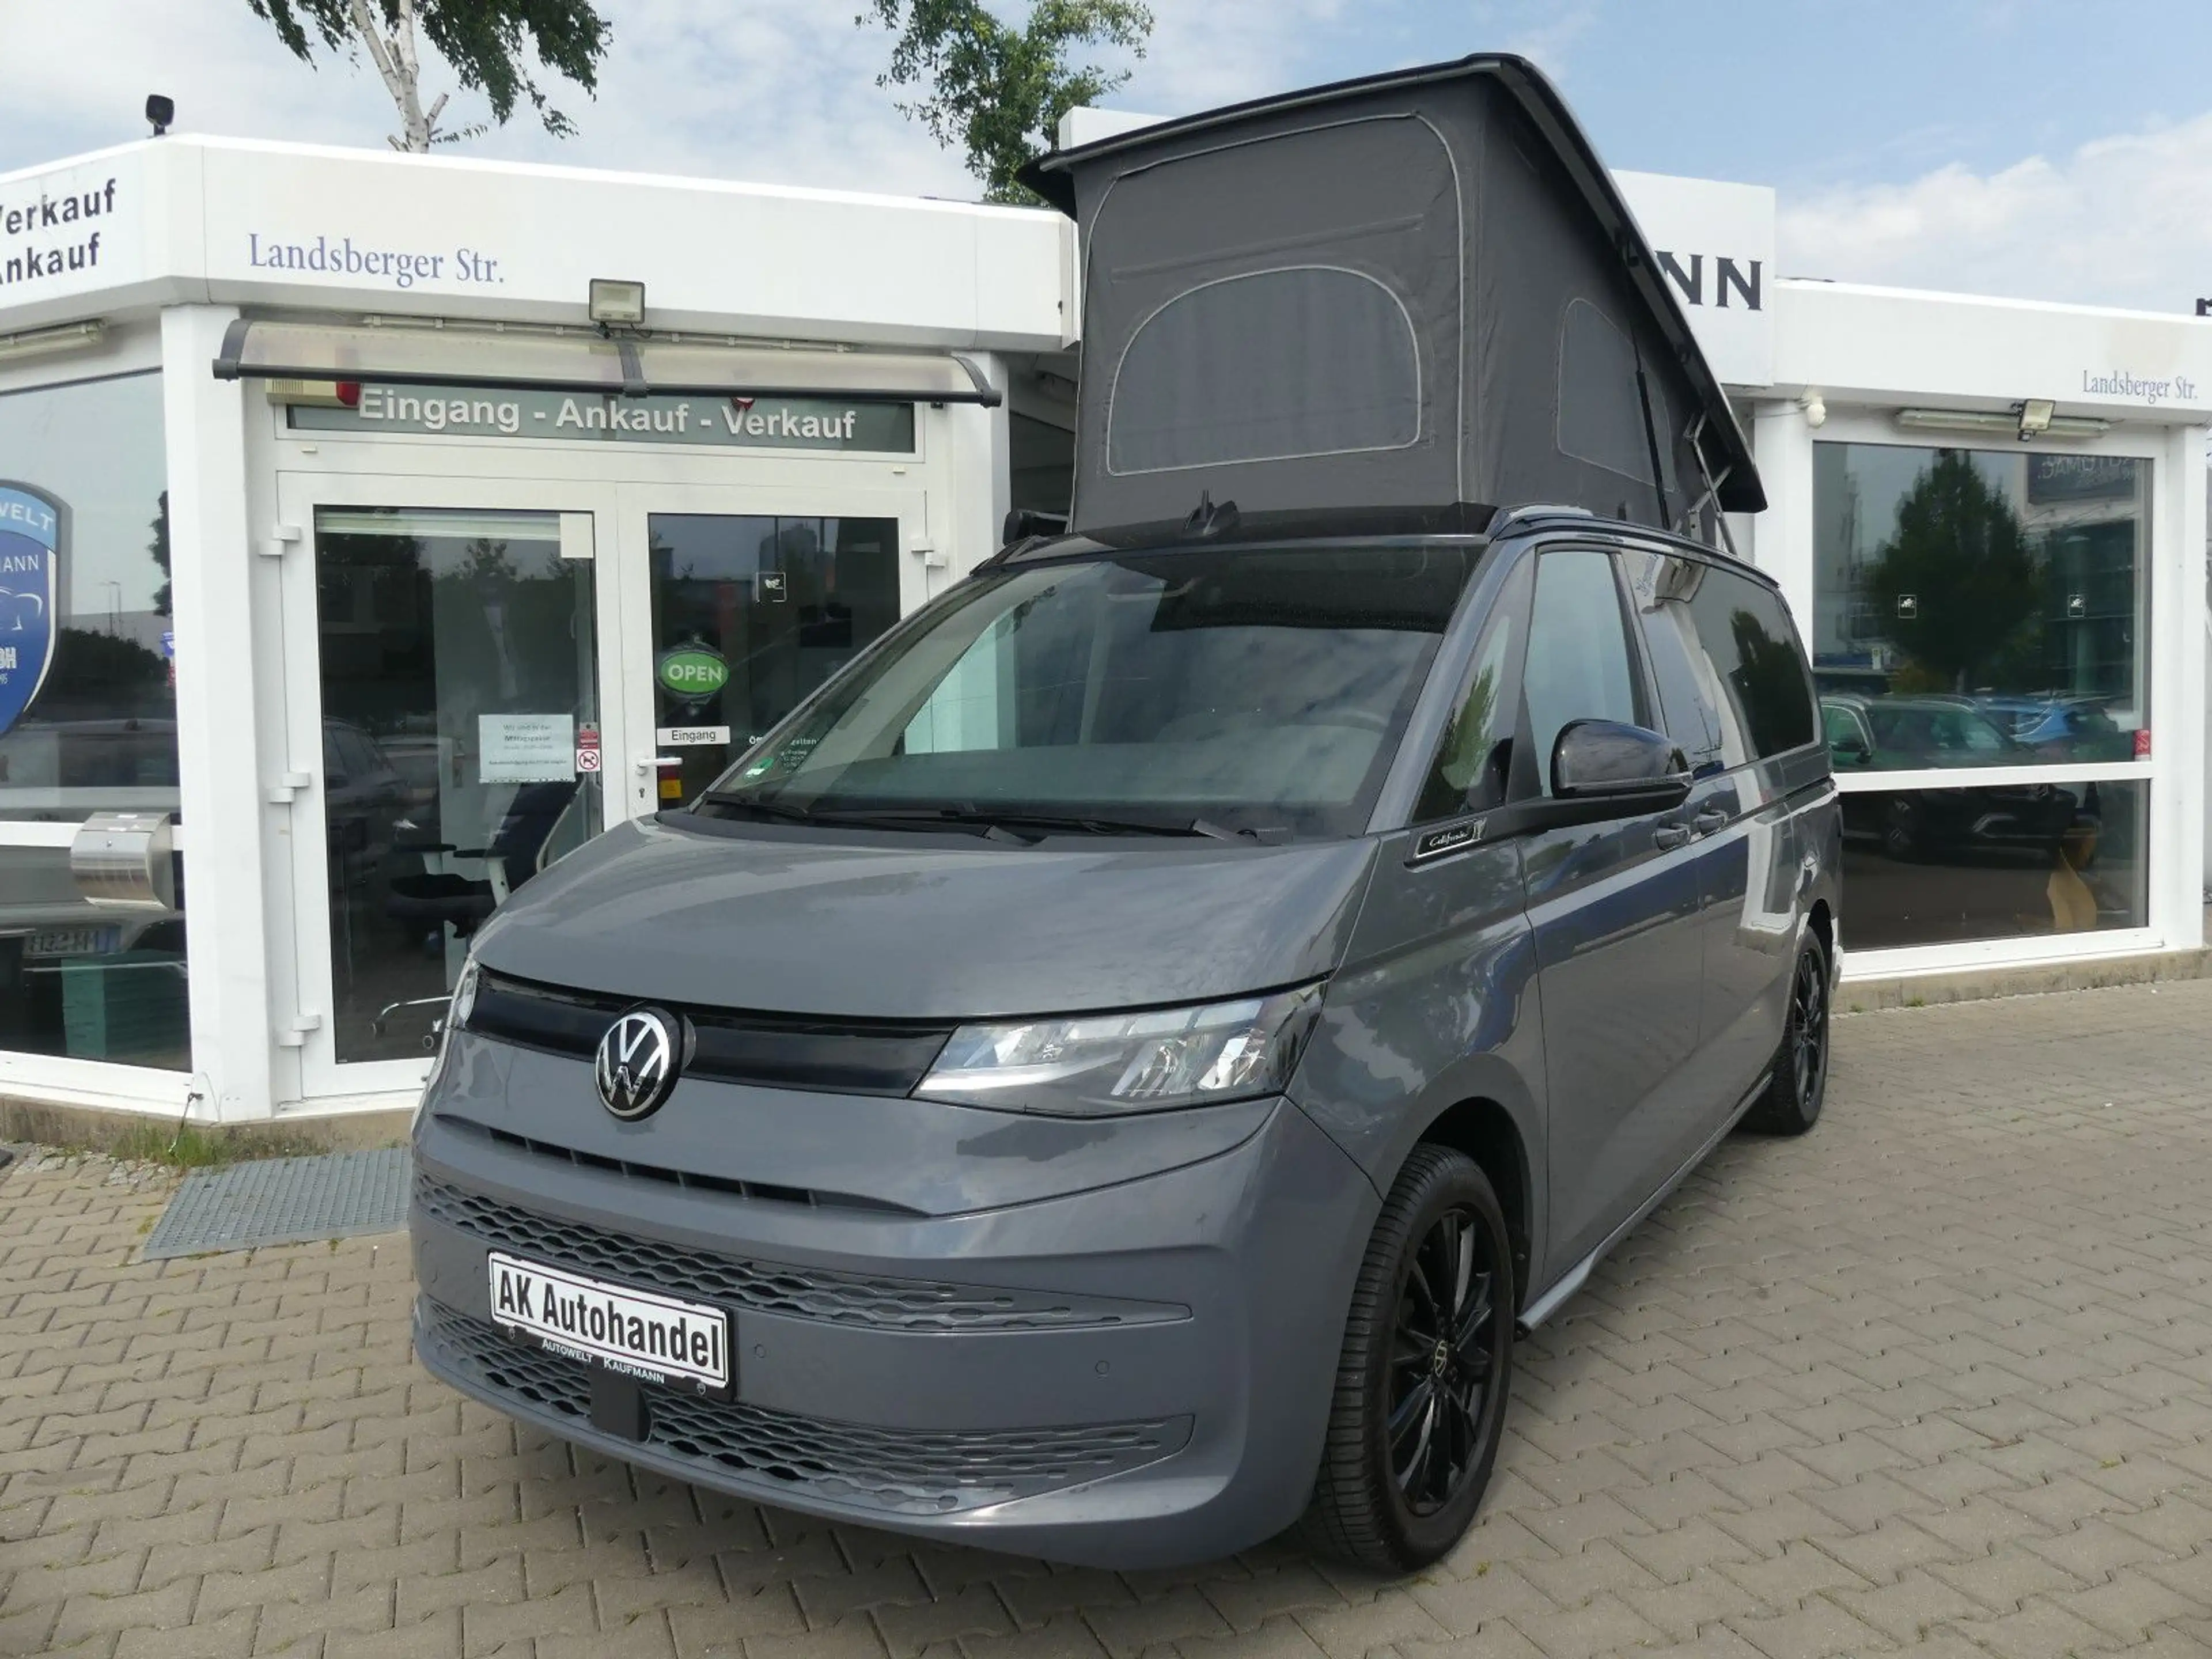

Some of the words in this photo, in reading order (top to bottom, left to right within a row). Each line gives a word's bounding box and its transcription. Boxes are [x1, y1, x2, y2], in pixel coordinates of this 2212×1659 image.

[0, 177, 116, 235] erkauf
[0, 232, 100, 285] nkauf
[248, 233, 445, 289] Landsberger
[456, 247, 505, 283] Str.
[2082, 369, 2171, 404] Landsberger
[2175, 376, 2198, 399] Str.
[358, 387, 520, 433] Eingang
[555, 397, 690, 433] Ankauf
[721, 404, 857, 440] Verkauf
[0, 554, 40, 573] ANN
[668, 664, 722, 683] OPEN
[671, 729, 717, 743] Eingang
[499, 1269, 535, 1319] AK
[543, 1282, 720, 1371] Autohandel
[541, 1338, 594, 1363] AUTOWELT
[603, 1357, 665, 1384] KAUFMANN
